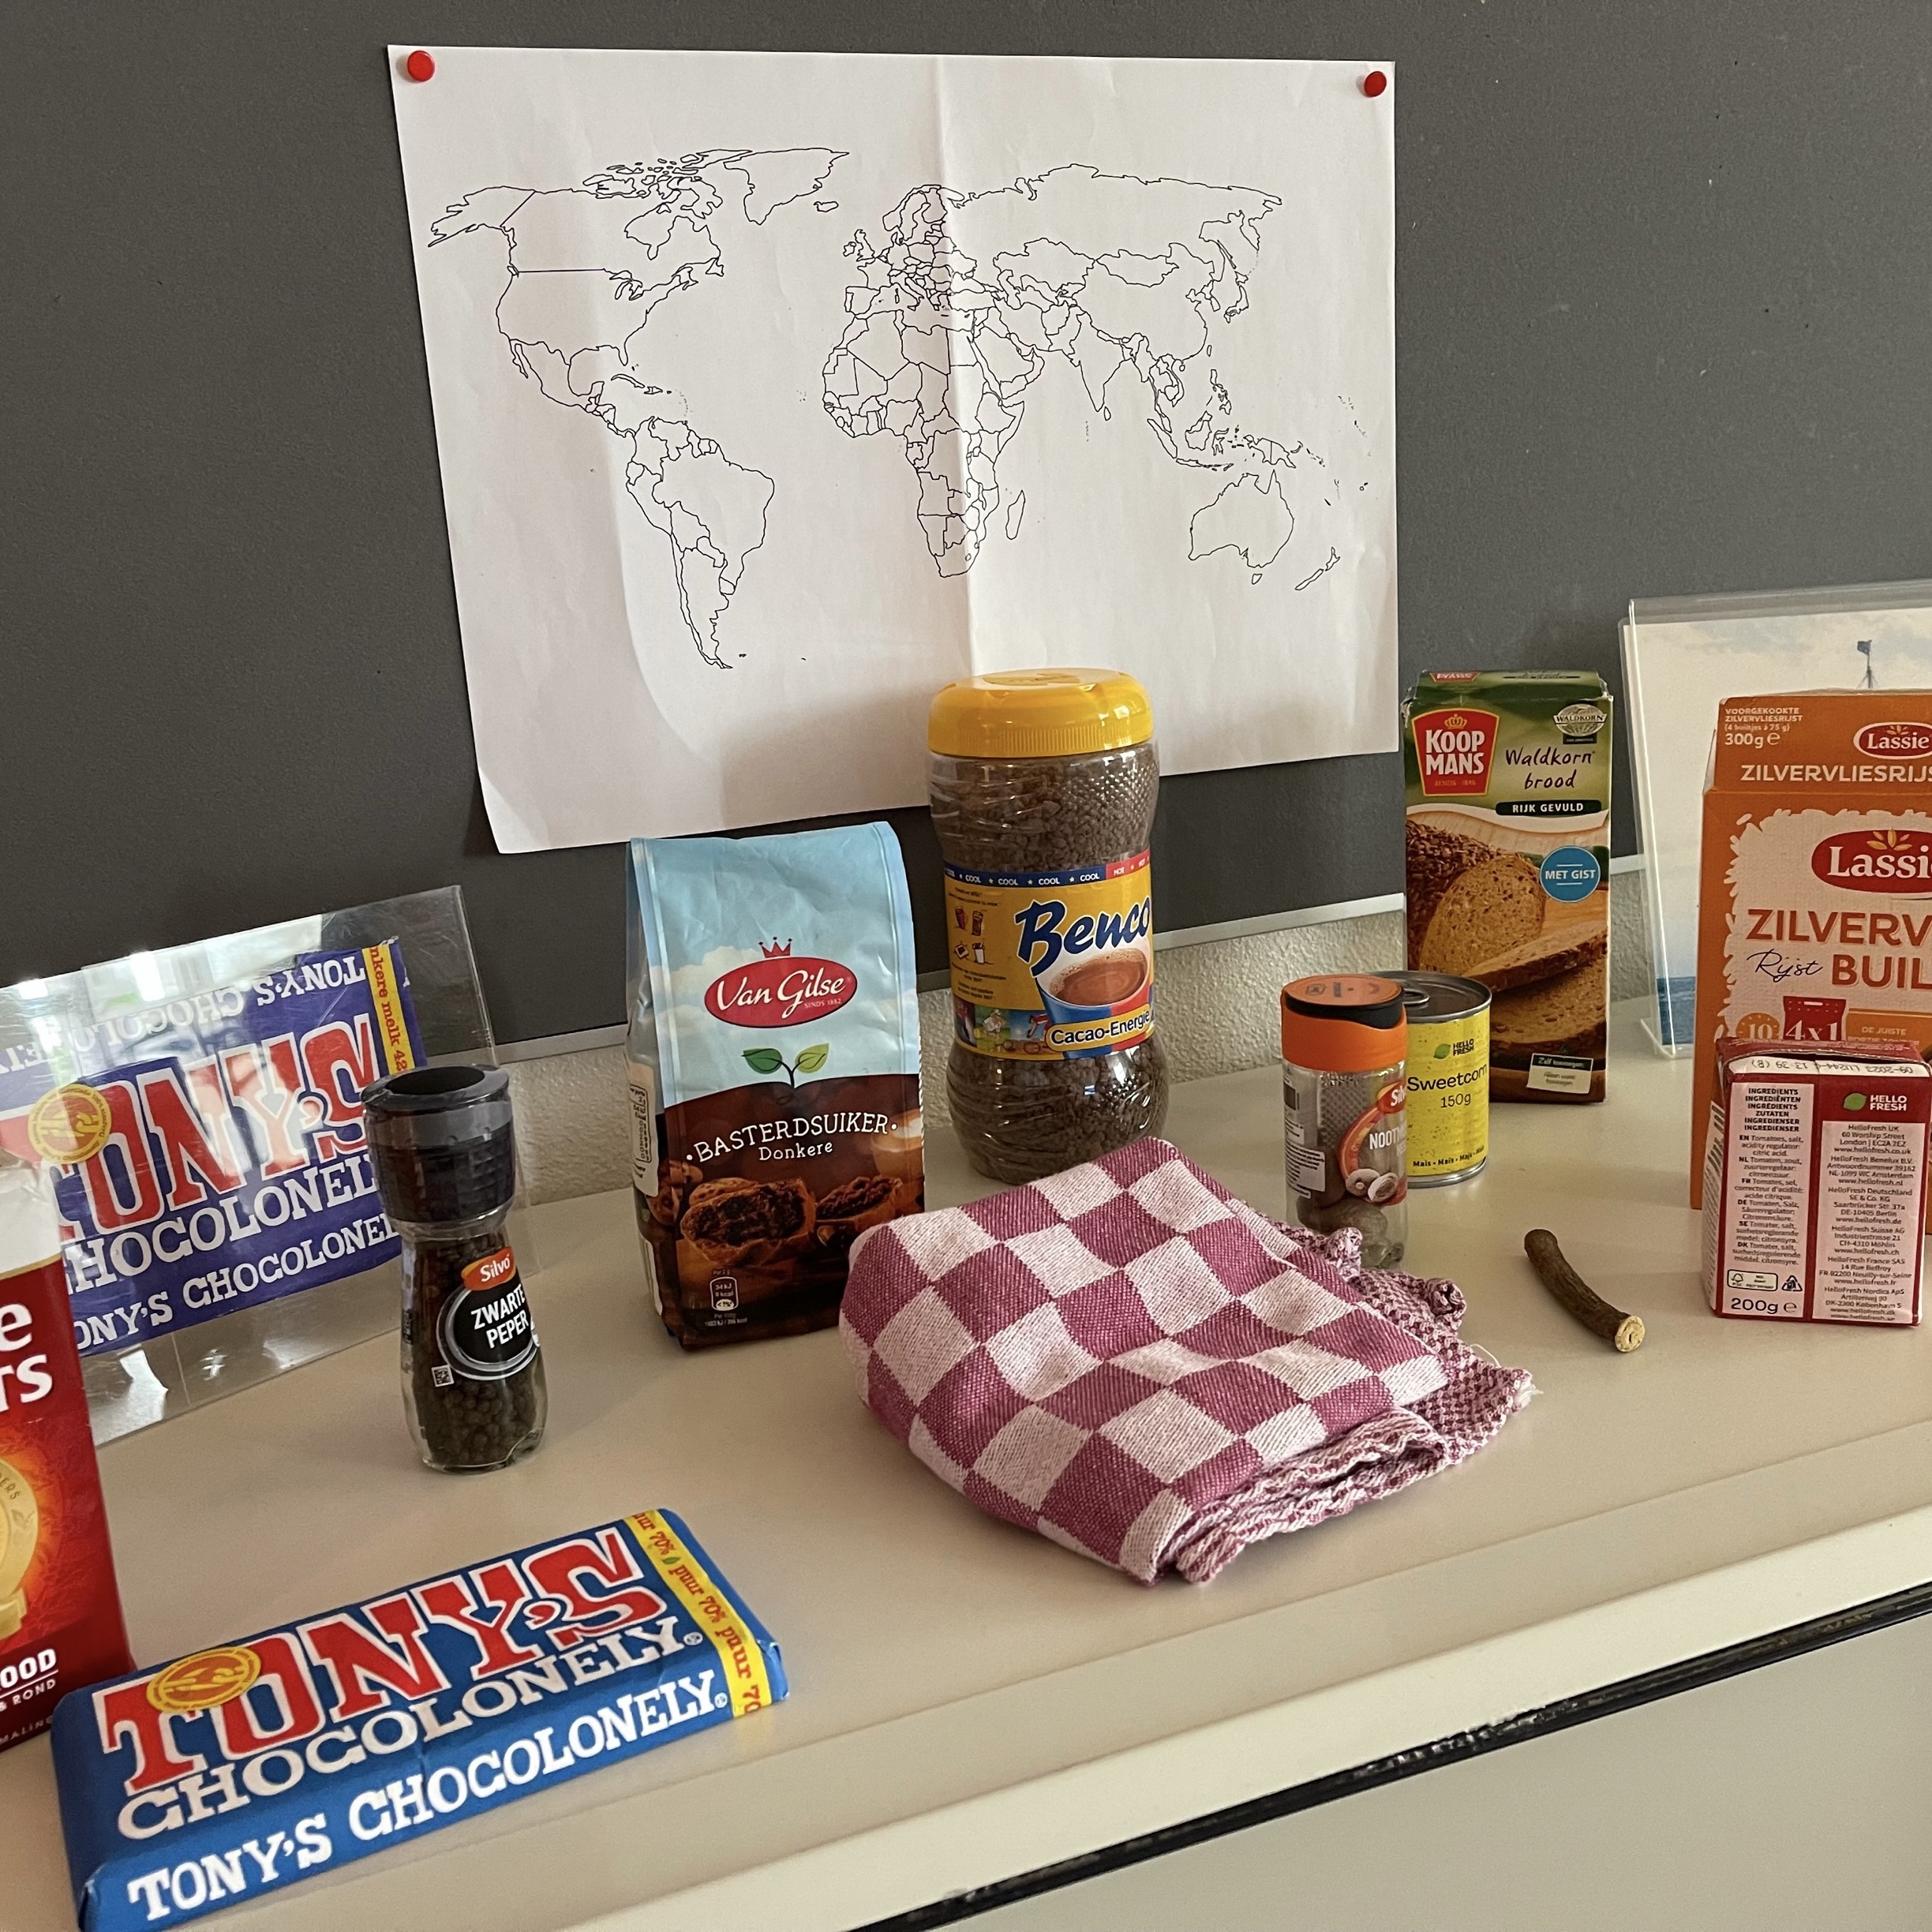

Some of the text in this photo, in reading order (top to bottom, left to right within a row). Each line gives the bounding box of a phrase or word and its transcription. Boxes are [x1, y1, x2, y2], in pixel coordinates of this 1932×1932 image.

[1425, 728, 1485, 754] KOOP
[1724, 732, 1764, 749] 300g
[1866, 732, 1930, 750] Lassie
[1425, 752, 1485, 776] MANS
[1505, 746, 1593, 766] Waldkorn
[1524, 769, 1577, 790] brood
[1740, 764, 1932, 783] ZILVERVLIESRIJS
[1512, 802, 1584, 814] RIJK GEVULD
[1544, 869, 1596, 880] MET GIST
[1826, 844, 1932, 879] Lassi
[964, 874, 982, 884] COOL
[998, 877, 1019, 886] COOL
[1038, 876, 1061, 886] COOL
[1080, 872, 1100, 882] COOL
[1014, 896, 1151, 977] Benco
[1746, 908, 1932, 947] ZILVERV
[1831, 953, 1932, 990] BUIL
[716, 967, 847, 1019] Van Gilse
[381, 1001, 402, 1047] melk
[1050, 1010, 1151, 1044] Cacao-Energie
[1453, 1038, 1474, 1050] HELLO
[1453, 1046, 1474, 1057] FRESH
[1406, 1063, 1488, 1091] Sweetcorn
[1440, 1093, 1471, 1109] 150g
[1870, 1095, 1908, 1103] HELLO
[1870, 1103, 1907, 1111] FRESH
[693, 1112, 889, 1163] BASTERDSUIKER
[758, 1141, 833, 1161] Donkere
[65, 1155, 379, 1297] HOCOLONEL
[73, 1291, 174, 1350] ONY'S
[182, 1211, 400, 1311] CHOCOLONEL
[479, 1252, 511, 1283] Silvo
[470, 1283, 526, 1331] ZWARTE
[1731, 1297, 1779, 1315] 200g
[485, 1309, 530, 1350] PEPER
[668, 1564, 706, 1596] puur
[714, 1626, 752, 1679] puur
[0, 1648, 57, 1689] OOD
[92, 1526, 668, 1797] TONY'S
[12, 1678, 56, 1705] ROND
[117, 1616, 685, 1840] CHOCOLONELY
[126, 1814, 332, 1921] TONY'S
[347, 1670, 717, 1841] CHOCOLONELY
